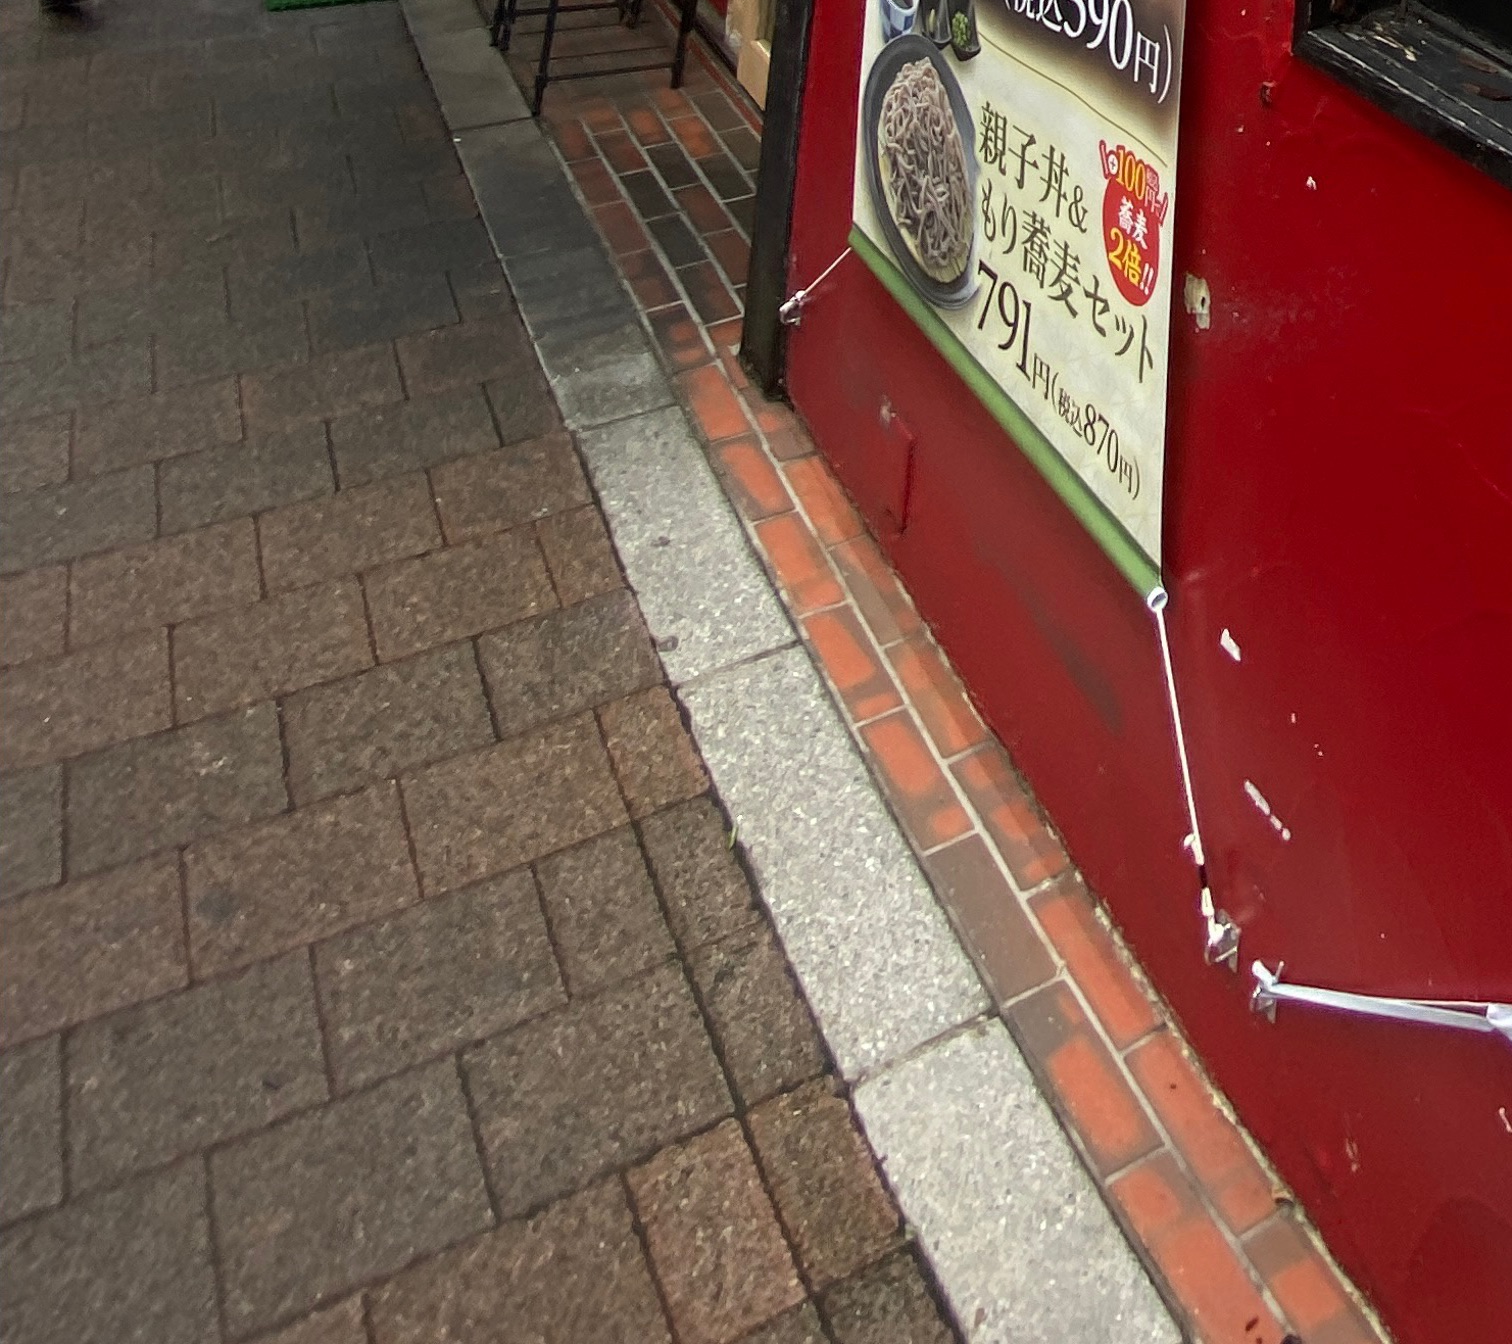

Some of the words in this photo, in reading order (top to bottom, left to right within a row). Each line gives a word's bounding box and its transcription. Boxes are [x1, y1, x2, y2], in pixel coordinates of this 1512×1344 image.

[981, 177, 1154, 384] もり蕎麦セット
[1118, 195, 1149, 250] 蕎麦
